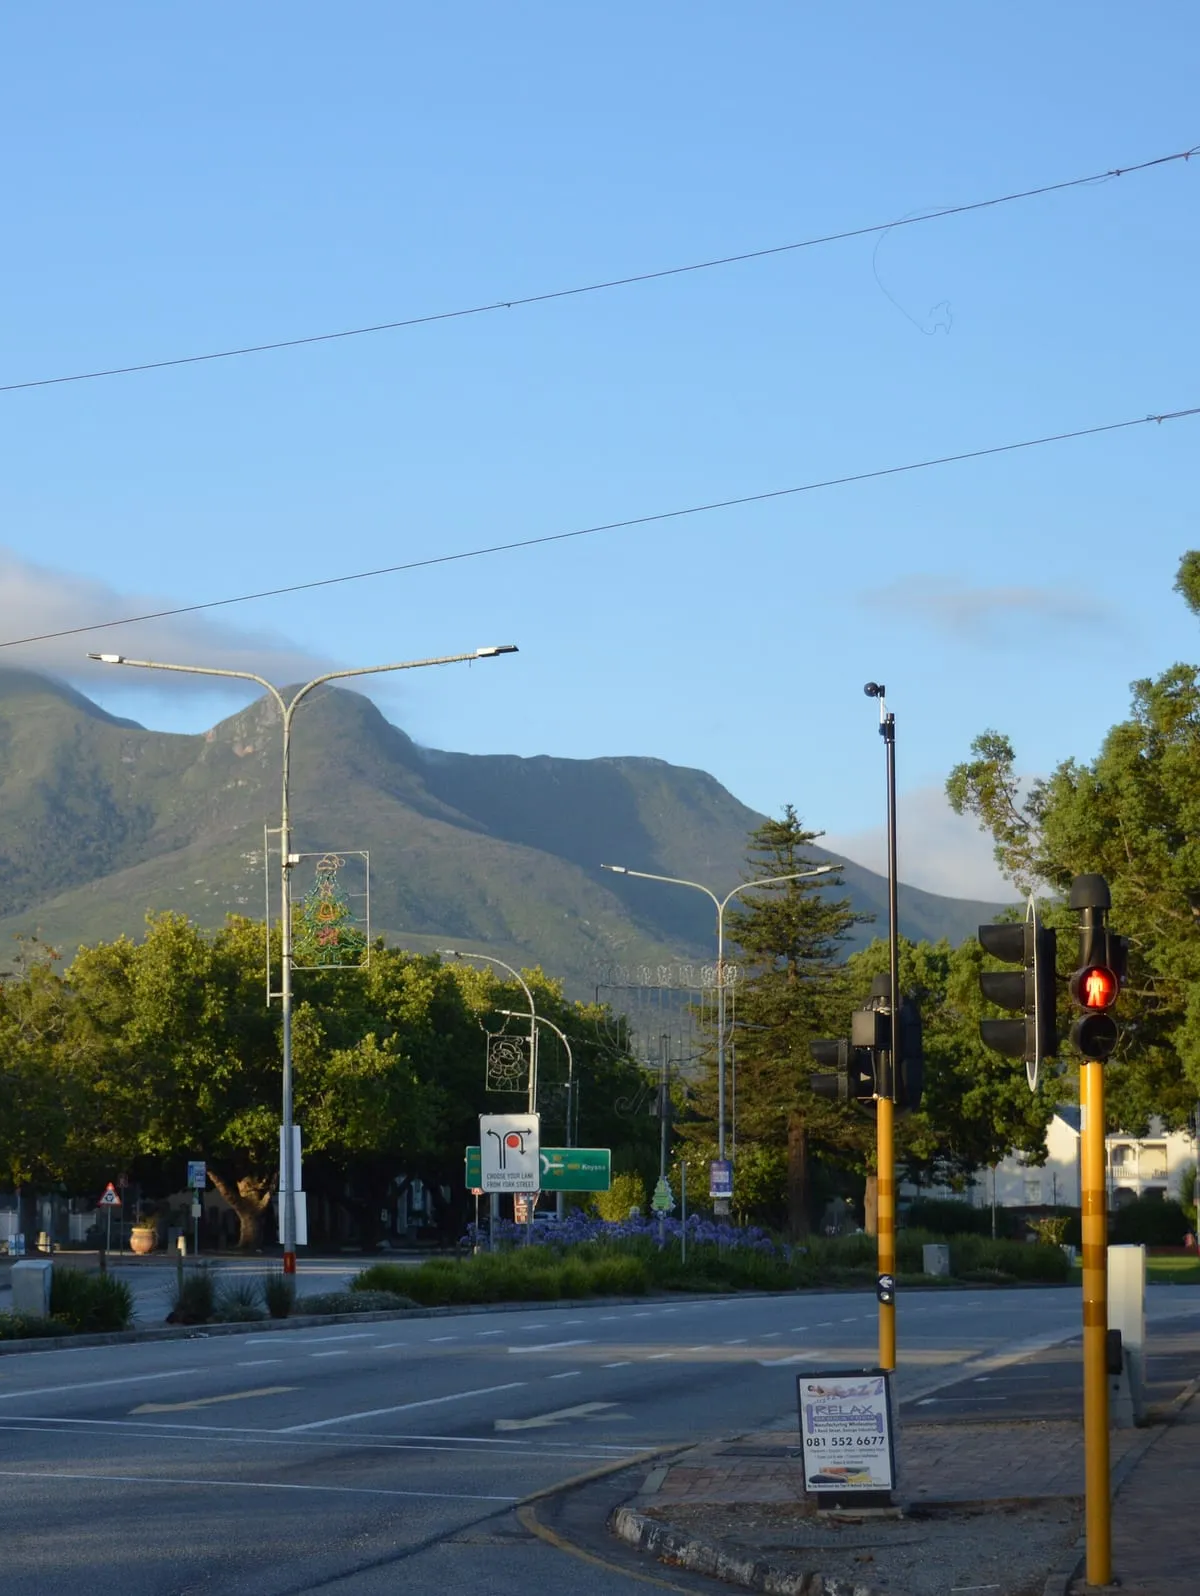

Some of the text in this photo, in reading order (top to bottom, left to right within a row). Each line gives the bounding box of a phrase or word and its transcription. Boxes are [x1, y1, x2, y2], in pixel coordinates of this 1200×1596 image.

[486, 1172, 506, 1180] CHOOSE
[815, 1404, 873, 1415] RELAX
[806, 1436, 885, 1447] 081 552 6677
